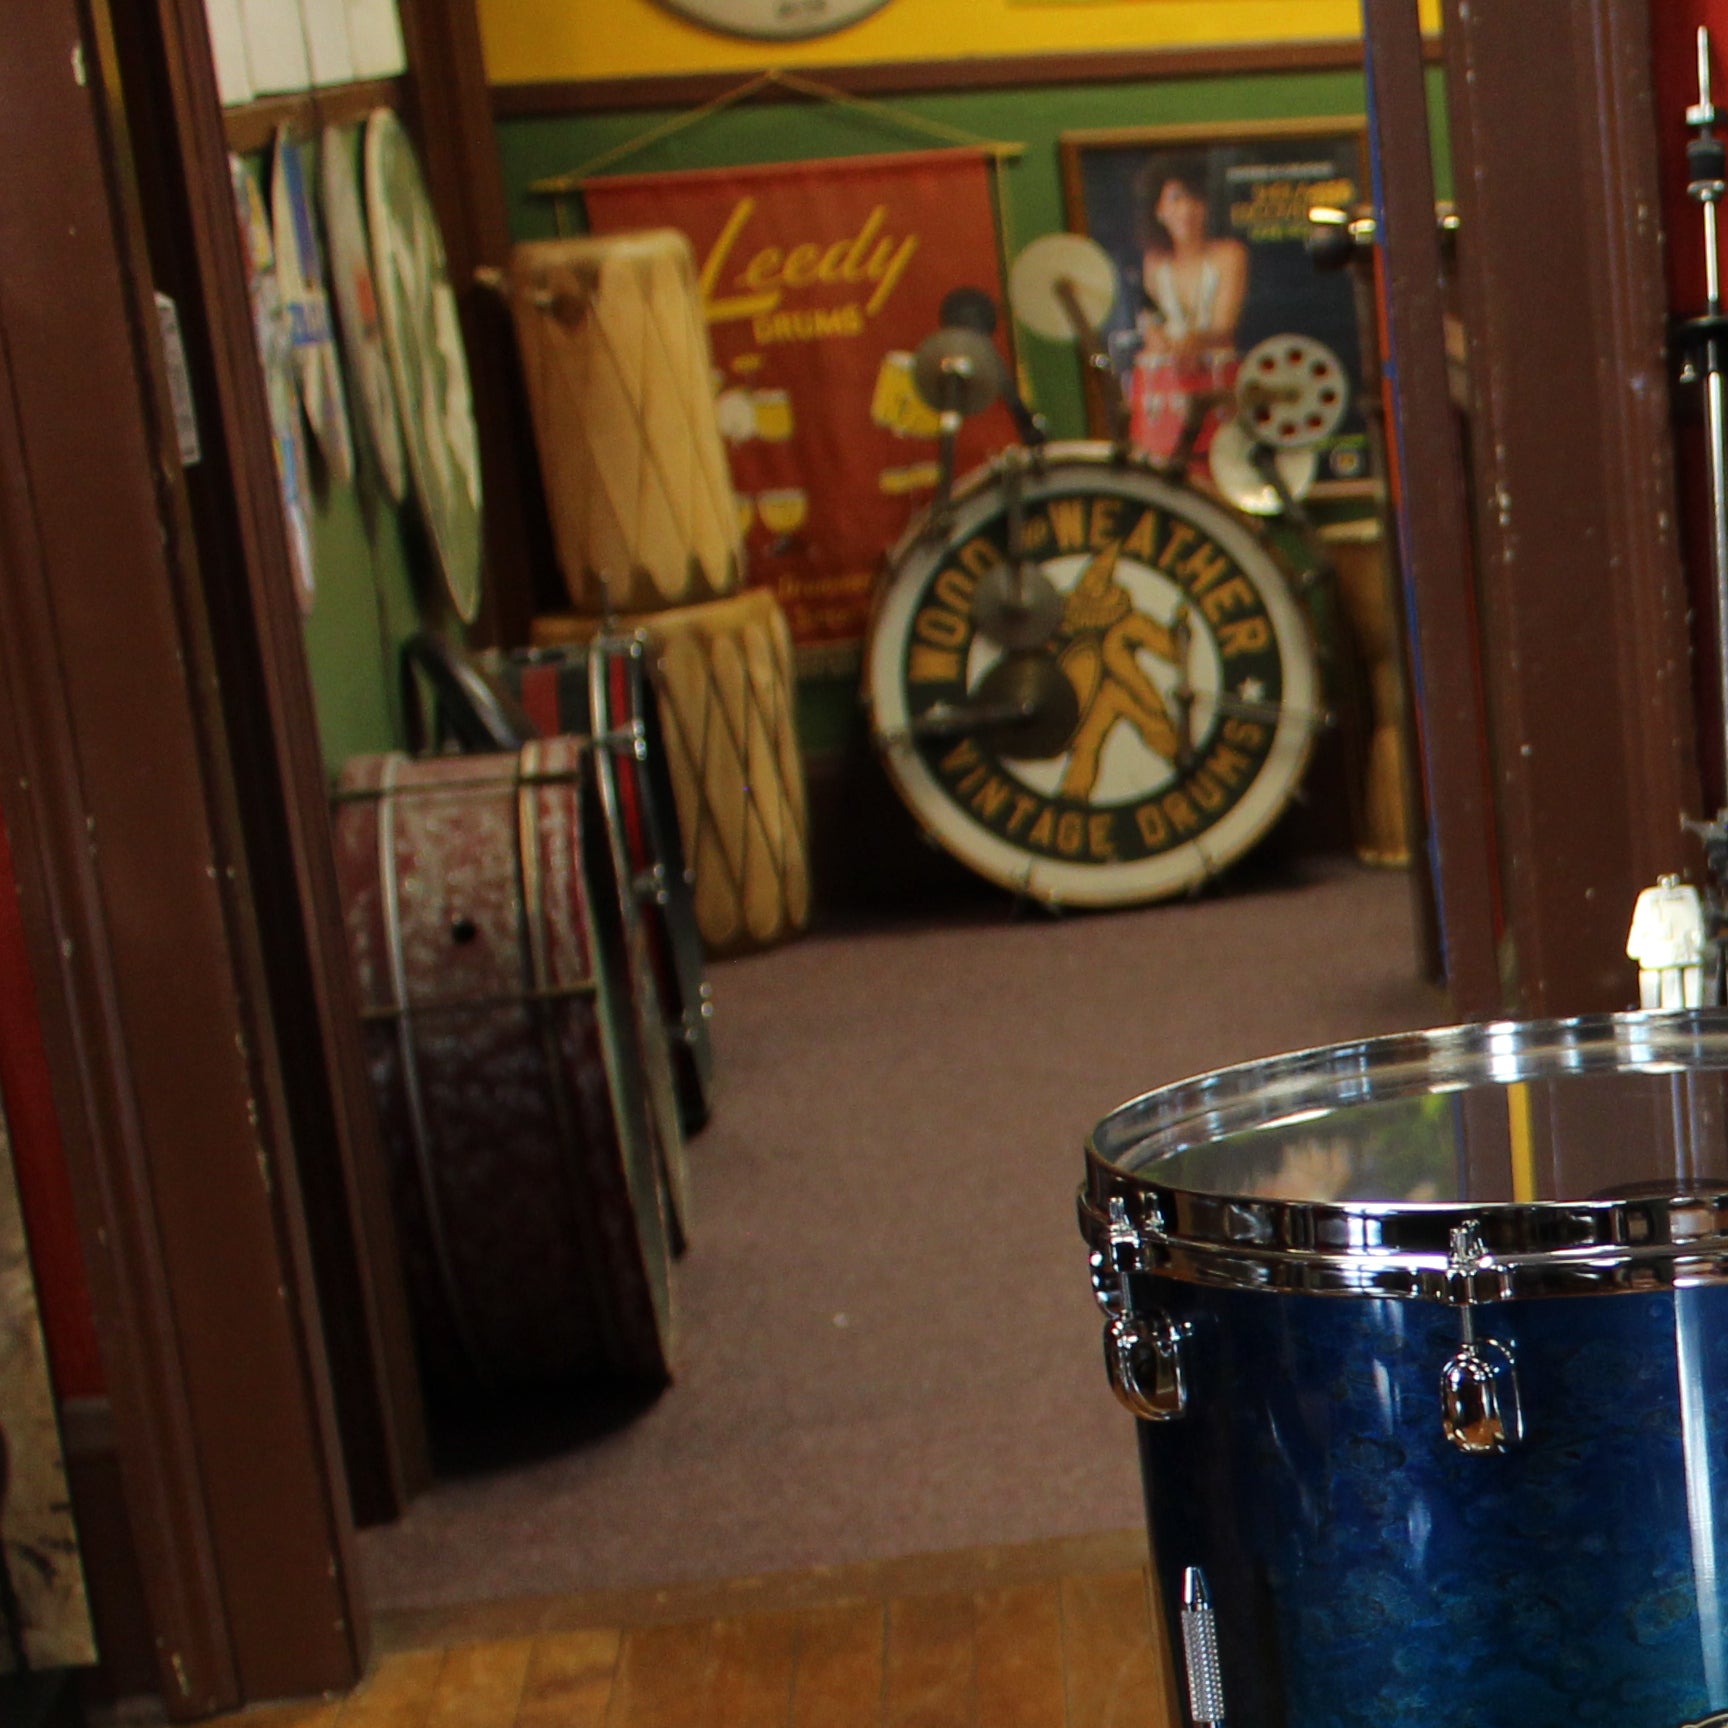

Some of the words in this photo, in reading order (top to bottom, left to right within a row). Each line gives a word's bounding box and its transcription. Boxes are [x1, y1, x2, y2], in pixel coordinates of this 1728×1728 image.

[701, 196, 919, 322] Leedy
[1047, 498, 1270, 657] WEATHER
[939, 738, 1117, 858] VINTAGE
[1135, 717, 1268, 848] DRUMS
